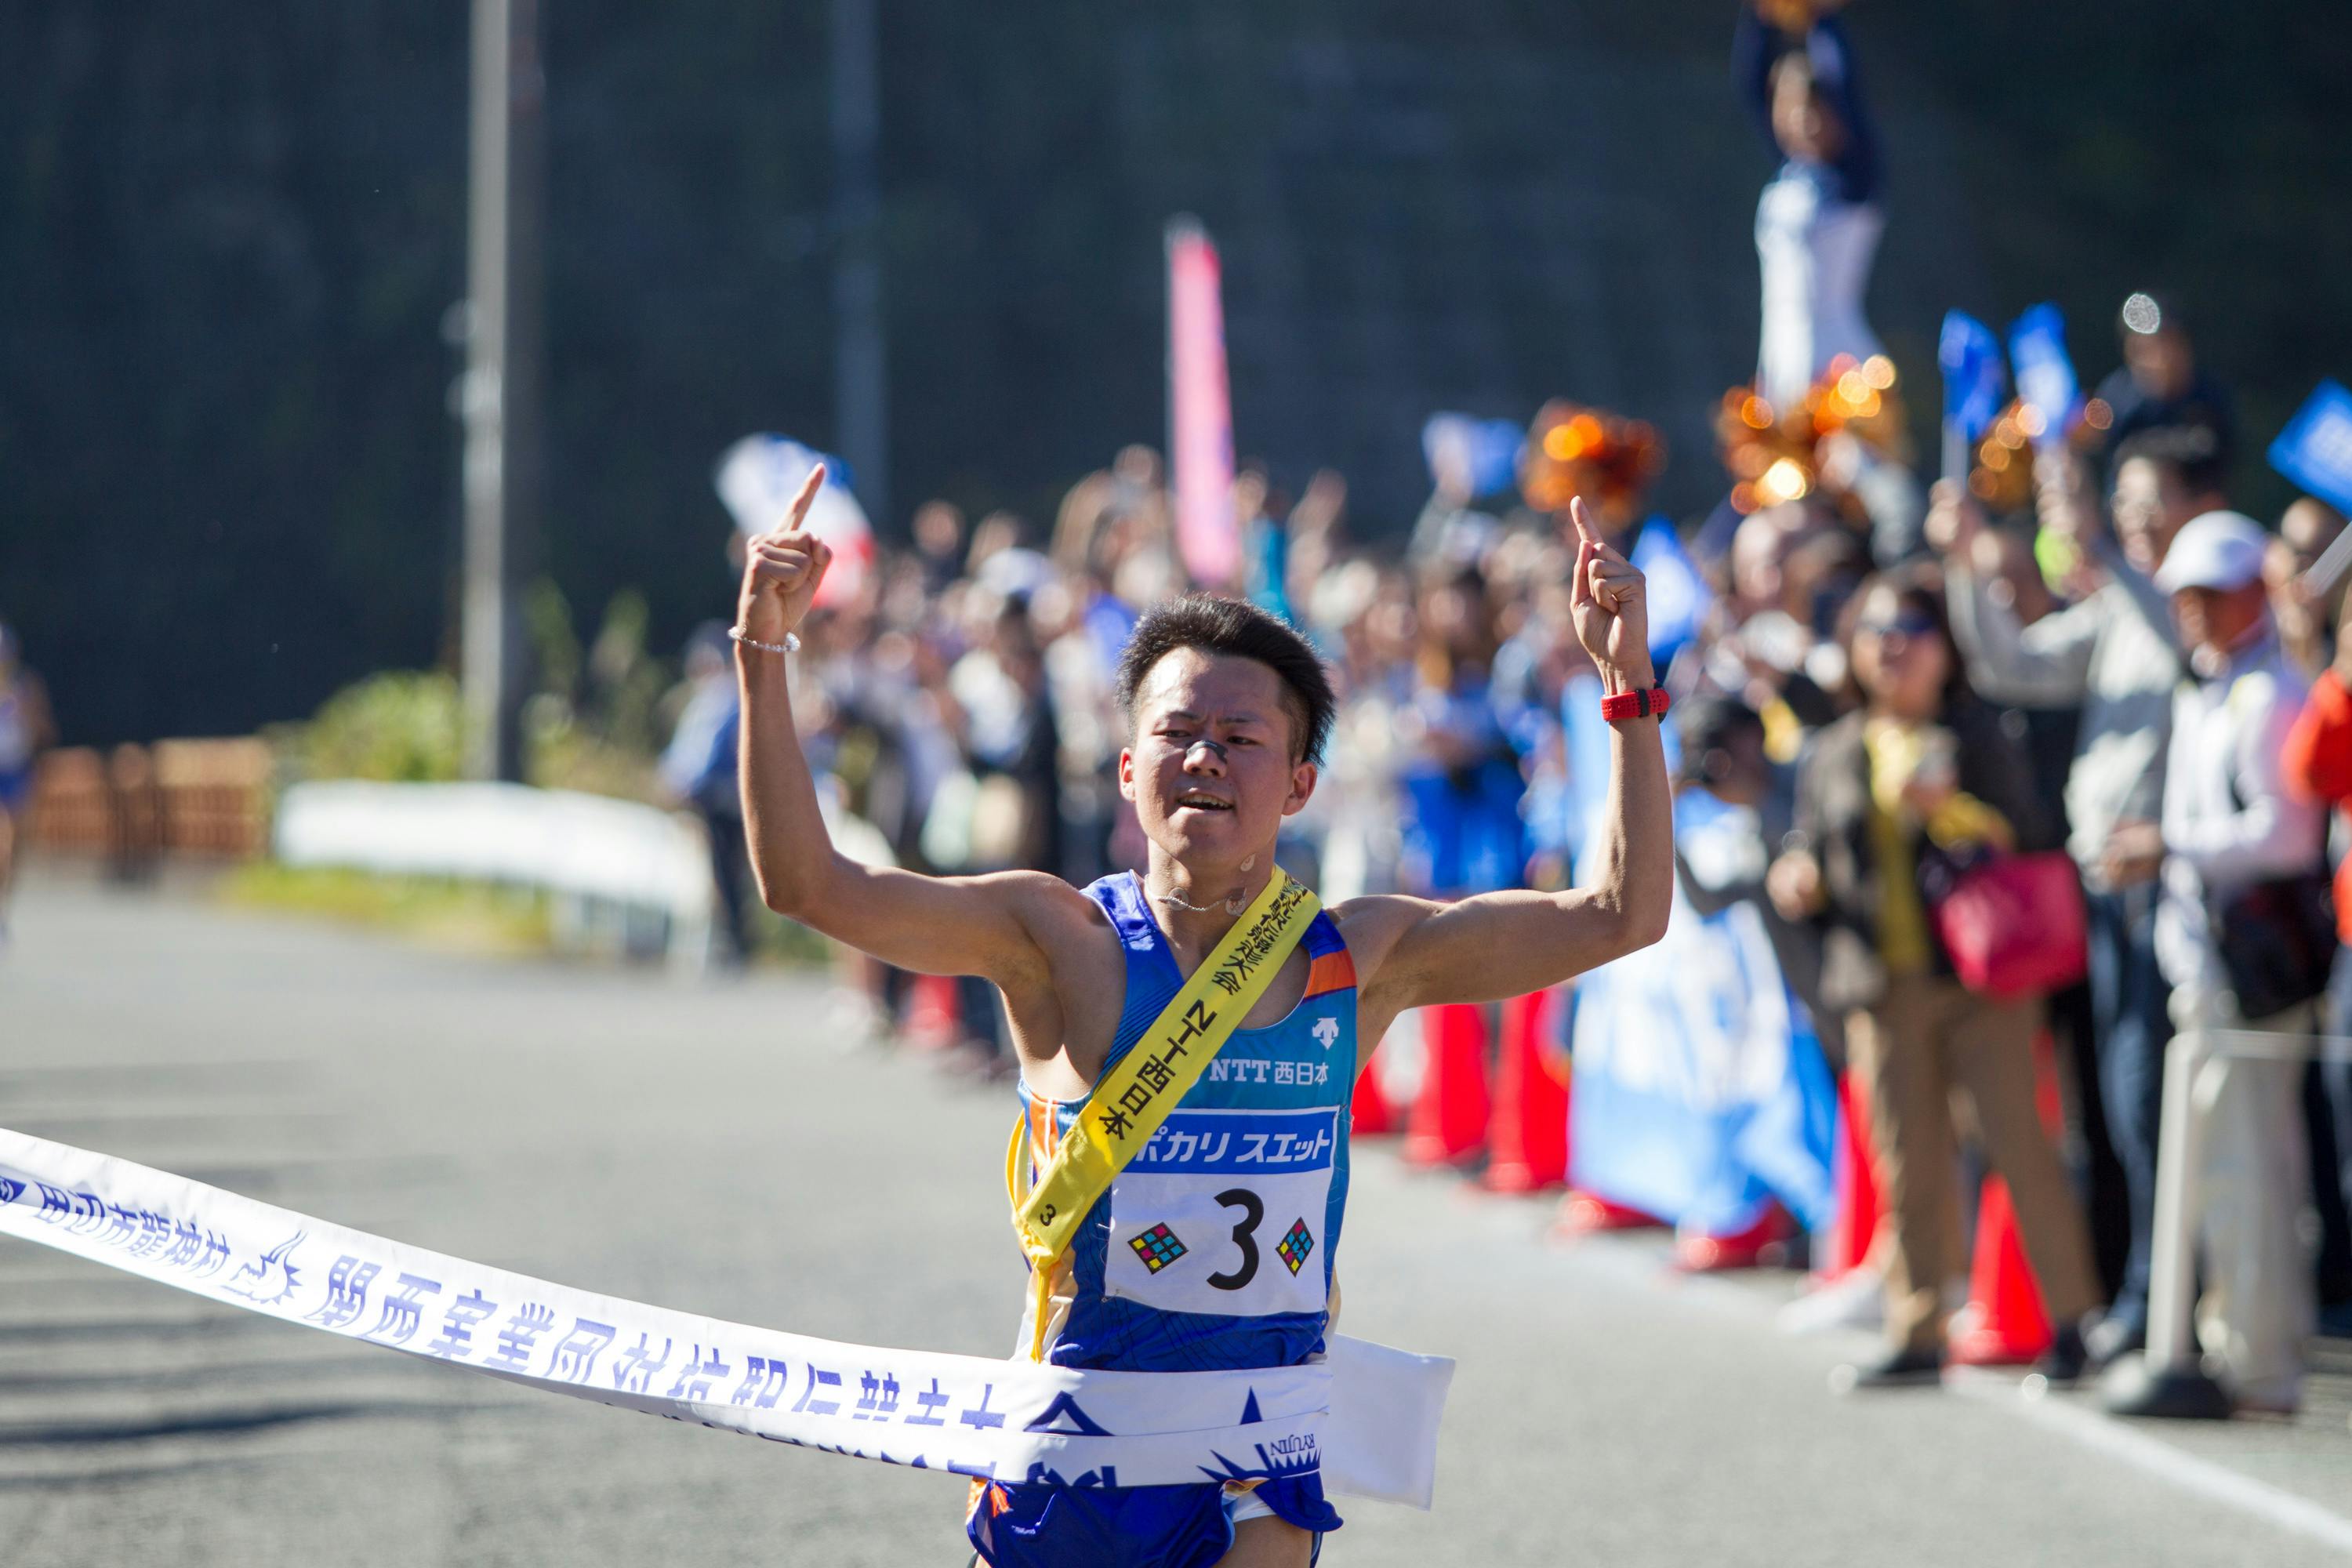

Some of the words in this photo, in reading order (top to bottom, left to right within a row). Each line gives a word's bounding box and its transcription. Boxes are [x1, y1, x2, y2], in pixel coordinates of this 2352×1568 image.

[1098, 999, 1218, 1141] NTT西日本
[1135, 1126, 1230, 1163] ポカリ
[1236, 1129, 1330, 1163] スエット
[1040, 1203, 1057, 1227] 3
[1207, 1188, 1265, 1291] 3
[1270, 1433, 1315, 1455] RYUJIN
